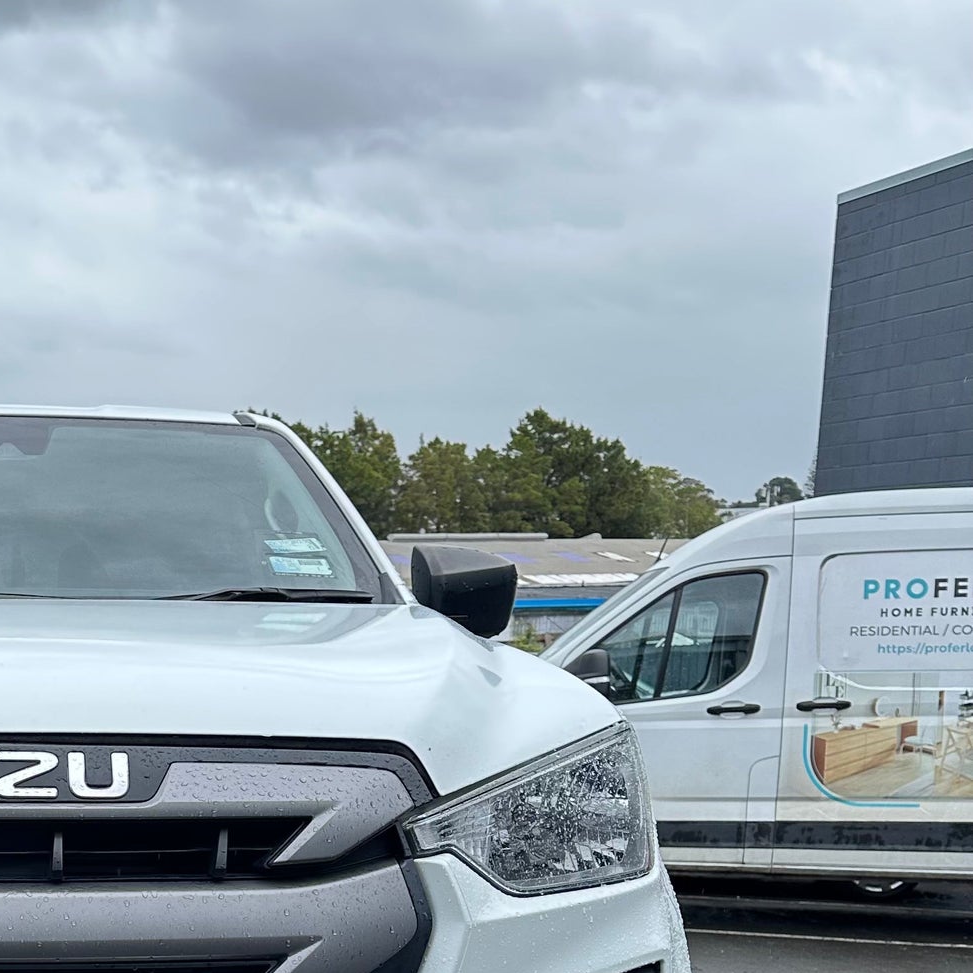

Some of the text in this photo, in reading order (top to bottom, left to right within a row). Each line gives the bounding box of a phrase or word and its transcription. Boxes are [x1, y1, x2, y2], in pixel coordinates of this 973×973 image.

[880, 606, 973, 618] HOME FURN
[850, 625, 939, 637] RESIDENTIAL
